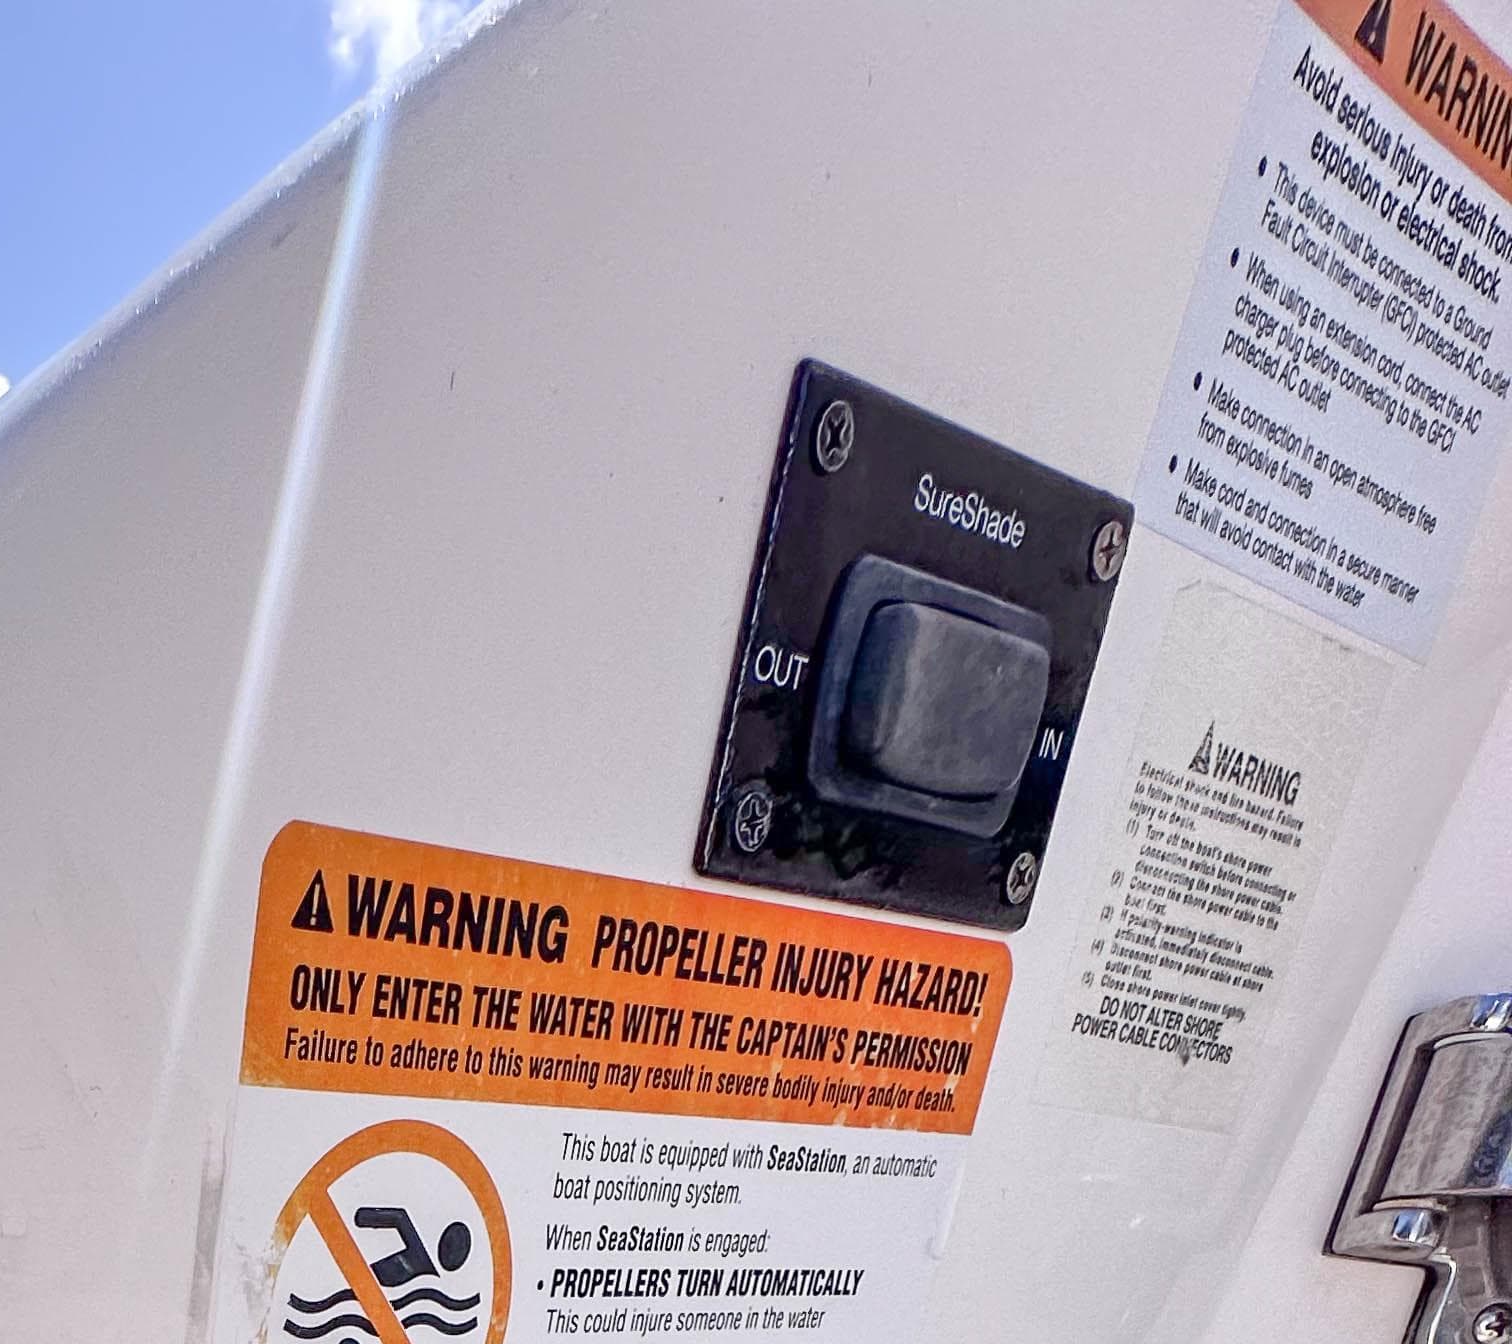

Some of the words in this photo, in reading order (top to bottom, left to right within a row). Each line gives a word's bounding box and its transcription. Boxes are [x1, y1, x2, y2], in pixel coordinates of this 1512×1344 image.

[1404, 10, 1512, 172] WARNIN
[1292, 45, 1343, 114] Avoid
[1337, 93, 1391, 160] serious
[1389, 133, 1433, 201] injury
[1430, 177, 1450, 208] or
[1446, 185, 1486, 240] death
[1310, 130, 1380, 209] explosion
[1380, 190, 1400, 222] or
[1396, 199, 1463, 271] electrical
[1457, 250, 1501, 304] shock.
[1273, 161, 1298, 206] This
[1297, 187, 1335, 235] device
[1333, 220, 1364, 258] must
[1361, 236, 1378, 269] be
[1377, 255, 1435, 309] connected
[1431, 290, 1445, 318] to
[1443, 304, 1454, 324] a
[1452, 305, 1493, 351] Ground
[1260, 198, 1293, 245] Fault
[1291, 223, 1329, 272] Circuit
[1326, 250, 1384, 311] Interrupter
[1380, 292, 1418, 342] (GFCI)
[1412, 322, 1467, 371] protected
[1462, 351, 1483, 381] AC
[1480, 367, 1510, 400] outlet
[1235, 292, 1280, 339] charger
[1275, 323, 1304, 363] plug
[1303, 335, 1340, 381] before
[1339, 367, 1397, 424] connecting
[1396, 400, 1409, 427] to
[1408, 409, 1427, 438] the
[1427, 418, 1456, 453] GFCI
[1245, 251, 1279, 300] When
[1278, 284, 1311, 328] using
[1309, 307, 1326, 333] an
[1325, 318, 1377, 368] extension
[1376, 354, 1405, 389] cord,
[1404, 373, 1447, 414] connect
[1445, 395, 1463, 424] the
[1460, 405, 1482, 435] AC
[914, 473, 1026, 549] SureShade
[755, 645, 809, 691] OUT
[1038, 727, 1065, 761] IN
[1214, 743, 1301, 806] WARNING
[348, 874, 568, 963] WARNING
[592, 915, 767, 988] PROPELLER
[771, 943, 874, 1002] INJURY
[873, 958, 988, 1017] HAZARD!
[290, 964, 366, 1015] ONLY
[372, 974, 462, 1025] ENTER
[472, 986, 522, 1031] THE
[529, 992, 614, 1040] WATER
[621, 1003, 684, 1046] WITH
[689, 1011, 733, 1051] THE
[736, 1017, 848, 1063] CAPTAIN'S
[850, 1030, 972, 1076] PERMISSION
[1071, 1012, 1118, 1040] POWER
[1118, 1022, 1159, 1048] CABLE
[1099, 995, 1119, 1017] DO
[1119, 1000, 1147, 1022] NOT
[1144, 1006, 1183, 1031] ALTER
[1183, 1014, 1223, 1041] SHORE
[284, 1027, 358, 1064] Failure
[365, 1036, 384, 1066] to
[390, 1039, 458, 1072] adhere
[465, 1045, 482, 1074] to
[488, 1046, 523, 1077] this
[529, 1054, 600, 1089] warning
[604, 1063, 641, 1093] may
[644, 1064, 694, 1091] result
[696, 1065, 713, 1092] in
[715, 1073, 769, 1097] severe
[772, 1072, 820, 1106] bodily
[821, 1076, 865, 1110] injury
[866, 1083, 914, 1110] and/or
[914, 1086, 954, 1112] death.
[552, 1172, 591, 1199] boat
[592, 1175, 682, 1208] positioning
[685, 1180, 741, 1208] system.
[562, 1132, 595, 1161] This
[599, 1134, 637, 1163] boat
[639, 1137, 654, 1164] is
[658, 1140, 729, 1172] equipped
[732, 1143, 763, 1169] with
[766, 1144, 847, 1176] SeaStation,
[852, 1155, 870, 1174] an
[872, 1153, 937, 1178] automatic
[546, 1223, 592, 1250] When
[596, 1224, 684, 1251] SeaStation
[687, 1227, 701, 1252] is
[705, 1229, 770, 1257] engaged:
[546, 1308, 579, 1334] This
[583, 1307, 628, 1333] could
[630, 1307, 672, 1337] injure
[675, 1311, 742, 1331] someone
[745, 1306, 759, 1329] in
[762, 1305, 784, 1329] the
[788, 1306, 826, 1328] water
[550, 1268, 671, 1298] PROPELLERS
[676, 1269, 724, 1297] TURN
[725, 1268, 864, 1296] AUTOMATICALLY
